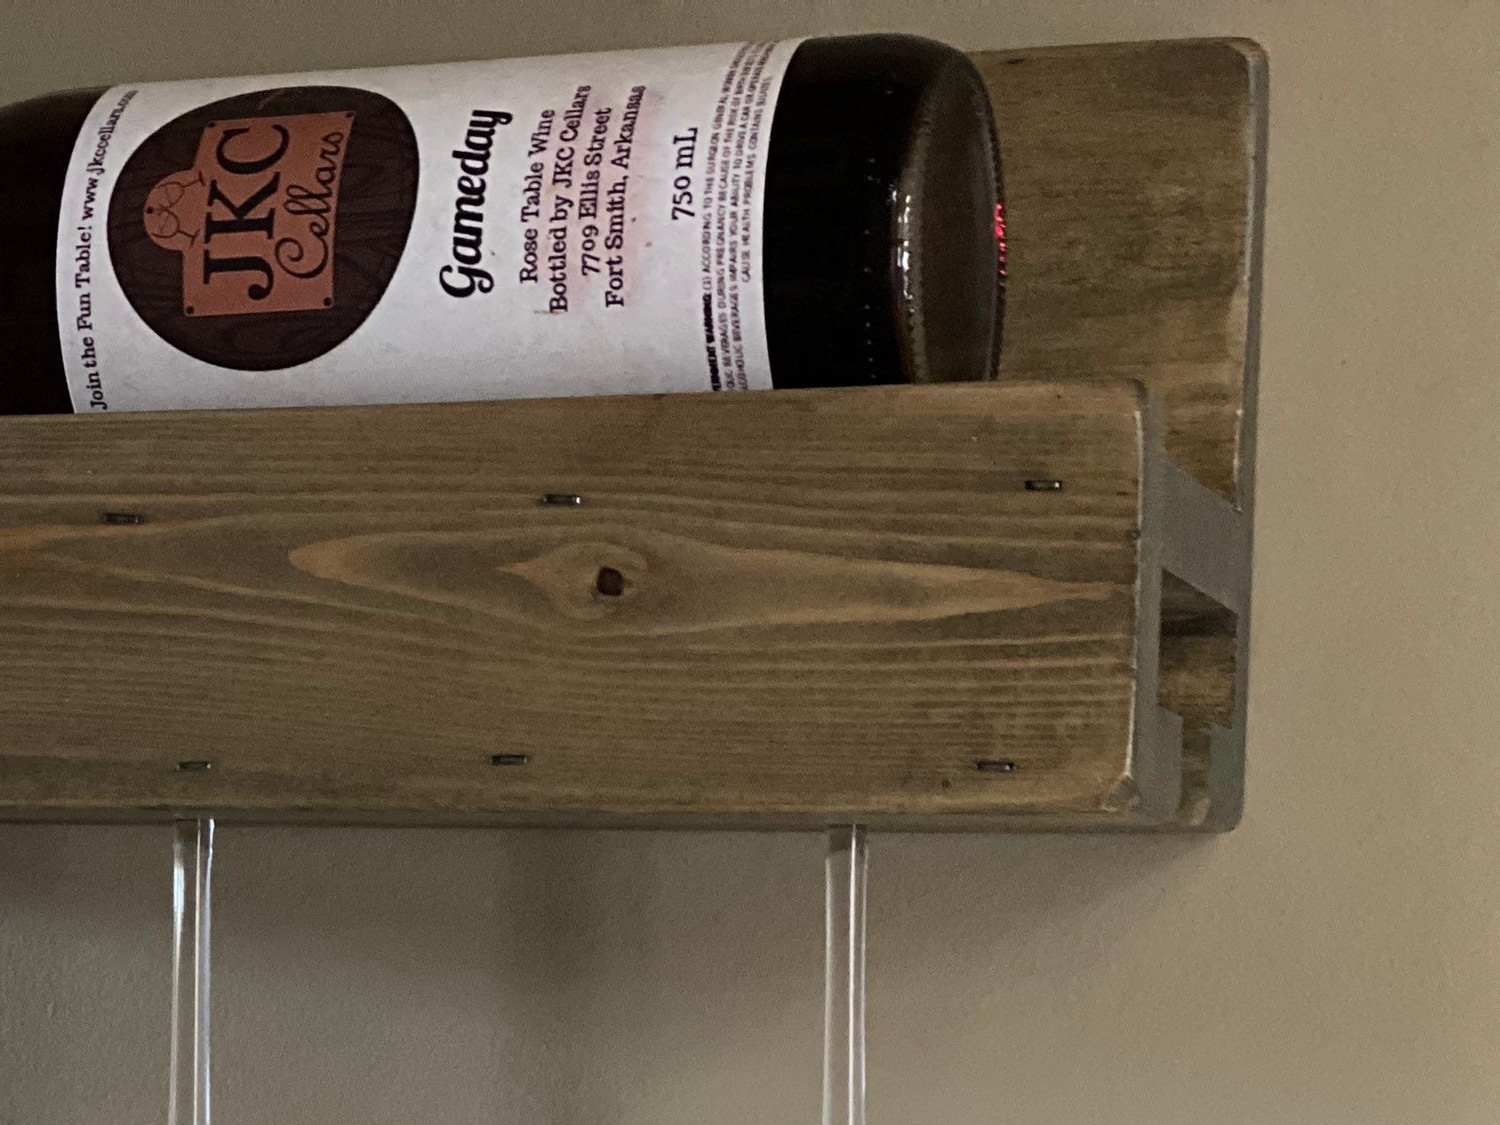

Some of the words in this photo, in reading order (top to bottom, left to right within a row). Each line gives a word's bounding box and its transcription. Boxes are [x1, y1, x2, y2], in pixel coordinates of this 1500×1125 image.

[527, 109, 556, 158] Wine
[559, 85, 592, 143] Cellars
[582, 106, 612, 167] Street
[610, 85, 647, 170] Arkansas
[551, 146, 576, 189] JKC
[672, 127, 698, 169] mL
[203, 124, 290, 300] JKC
[273, 131, 344, 279] Cellars
[438, 109, 513, 298] Gameday
[520, 161, 544, 223] Table
[549, 195, 574, 223] by
[577, 169, 601, 220] Ellis
[603, 175, 629, 250] Smith,
[671, 175, 695, 221] 750
[74, 225, 93, 289] Table!
[518, 228, 539, 284] Rose
[548, 226, 569, 313] Bottled
[581, 224, 601, 276] 7709
[604, 255, 625, 308] Fort
[76, 292, 94, 332] Fun
[80, 336, 98, 368] the
[85, 371, 108, 411] Join
